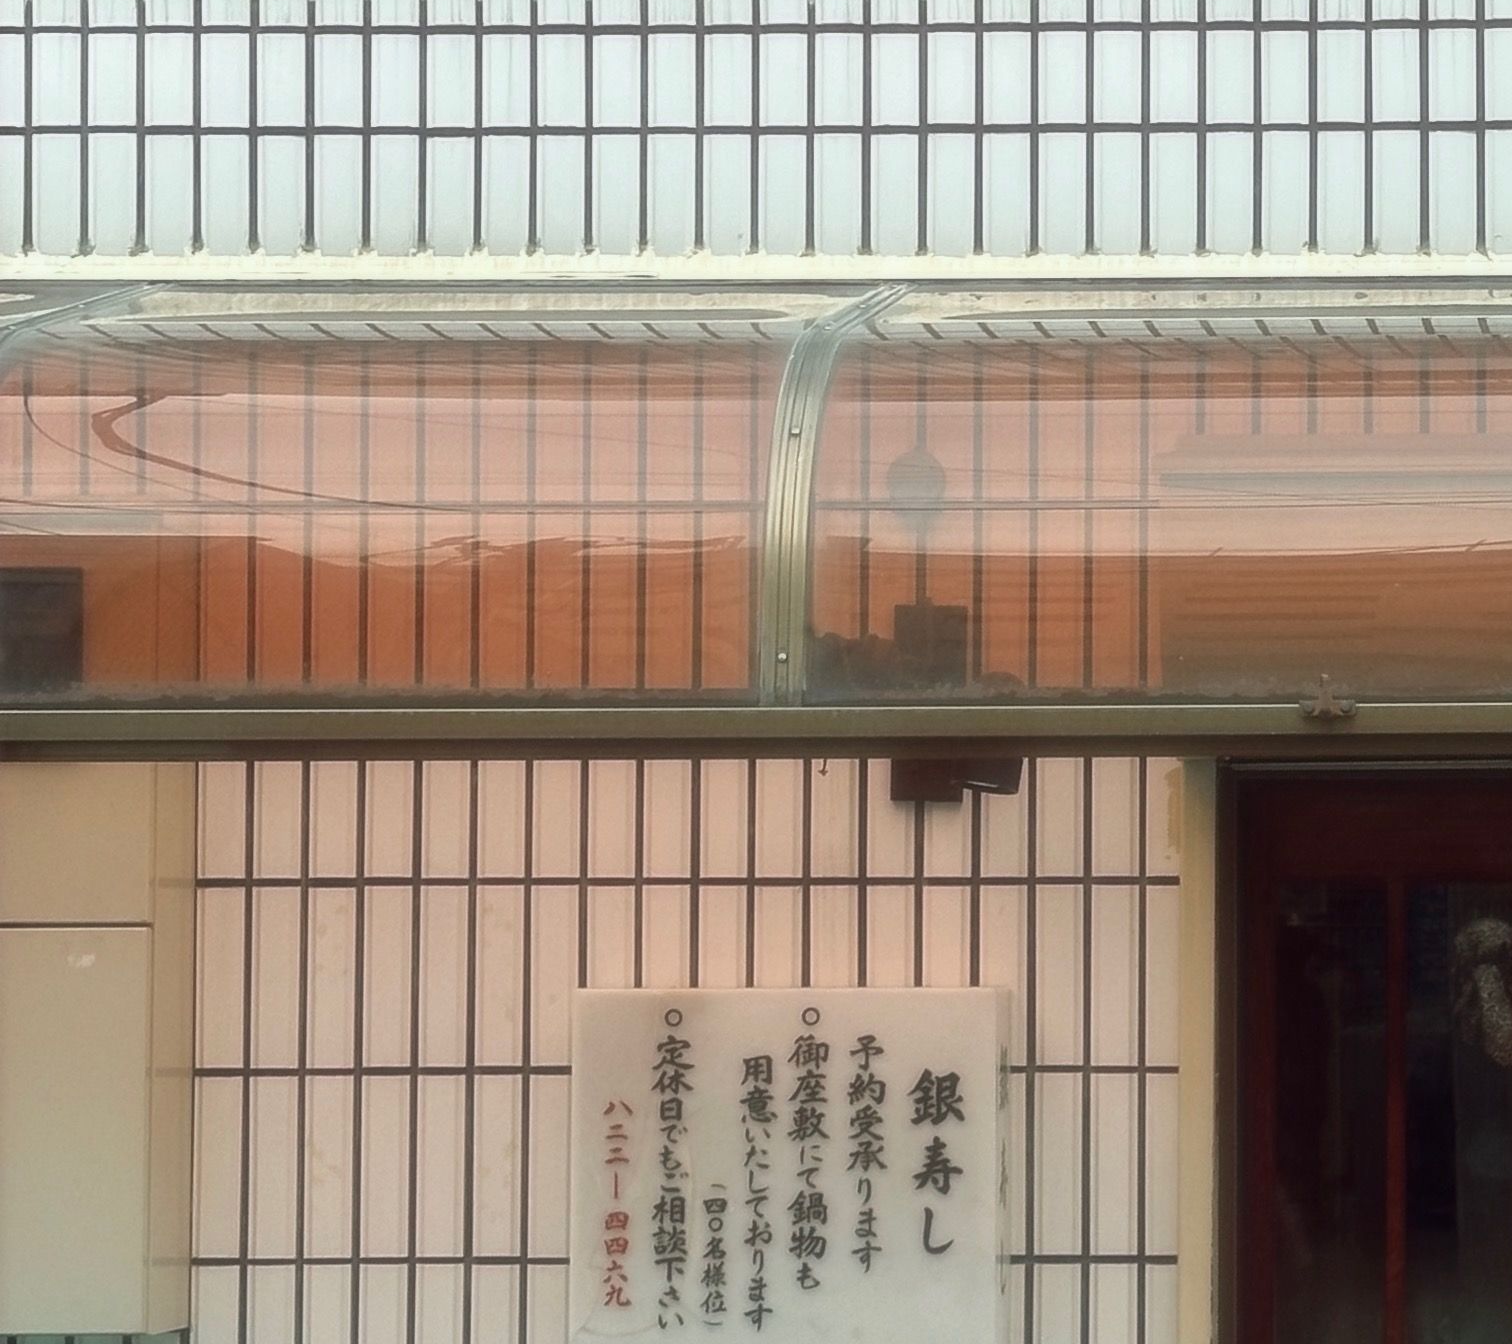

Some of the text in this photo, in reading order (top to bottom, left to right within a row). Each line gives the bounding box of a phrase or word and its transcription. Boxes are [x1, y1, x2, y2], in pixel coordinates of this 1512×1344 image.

[651, 1034, 695, 1330] 定休日でもご相談下さい
[739, 1055, 778, 1333] 用意いたしております
[846, 1034, 888, 1274] 予約受承ります
[907, 1067, 966, 1256] 銀寿し
